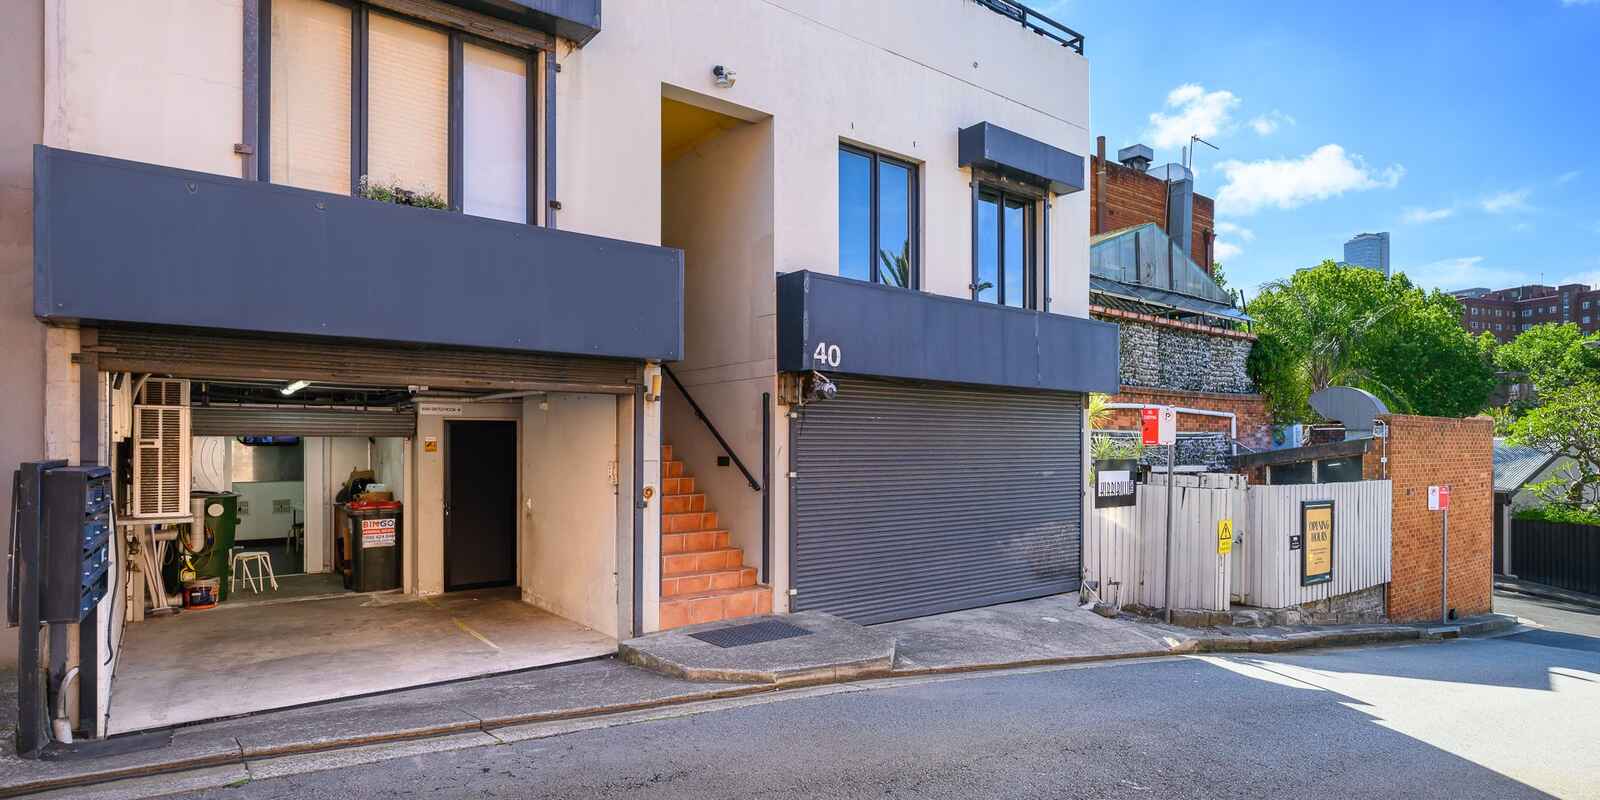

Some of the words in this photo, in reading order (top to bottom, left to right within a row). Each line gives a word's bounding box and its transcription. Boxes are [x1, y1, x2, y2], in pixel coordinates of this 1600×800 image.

[813, 342, 841, 367] 40
[363, 519, 395, 528] BINGO
[1308, 520, 1329, 530] OPENING
[1311, 531, 1328, 542] HOURS
